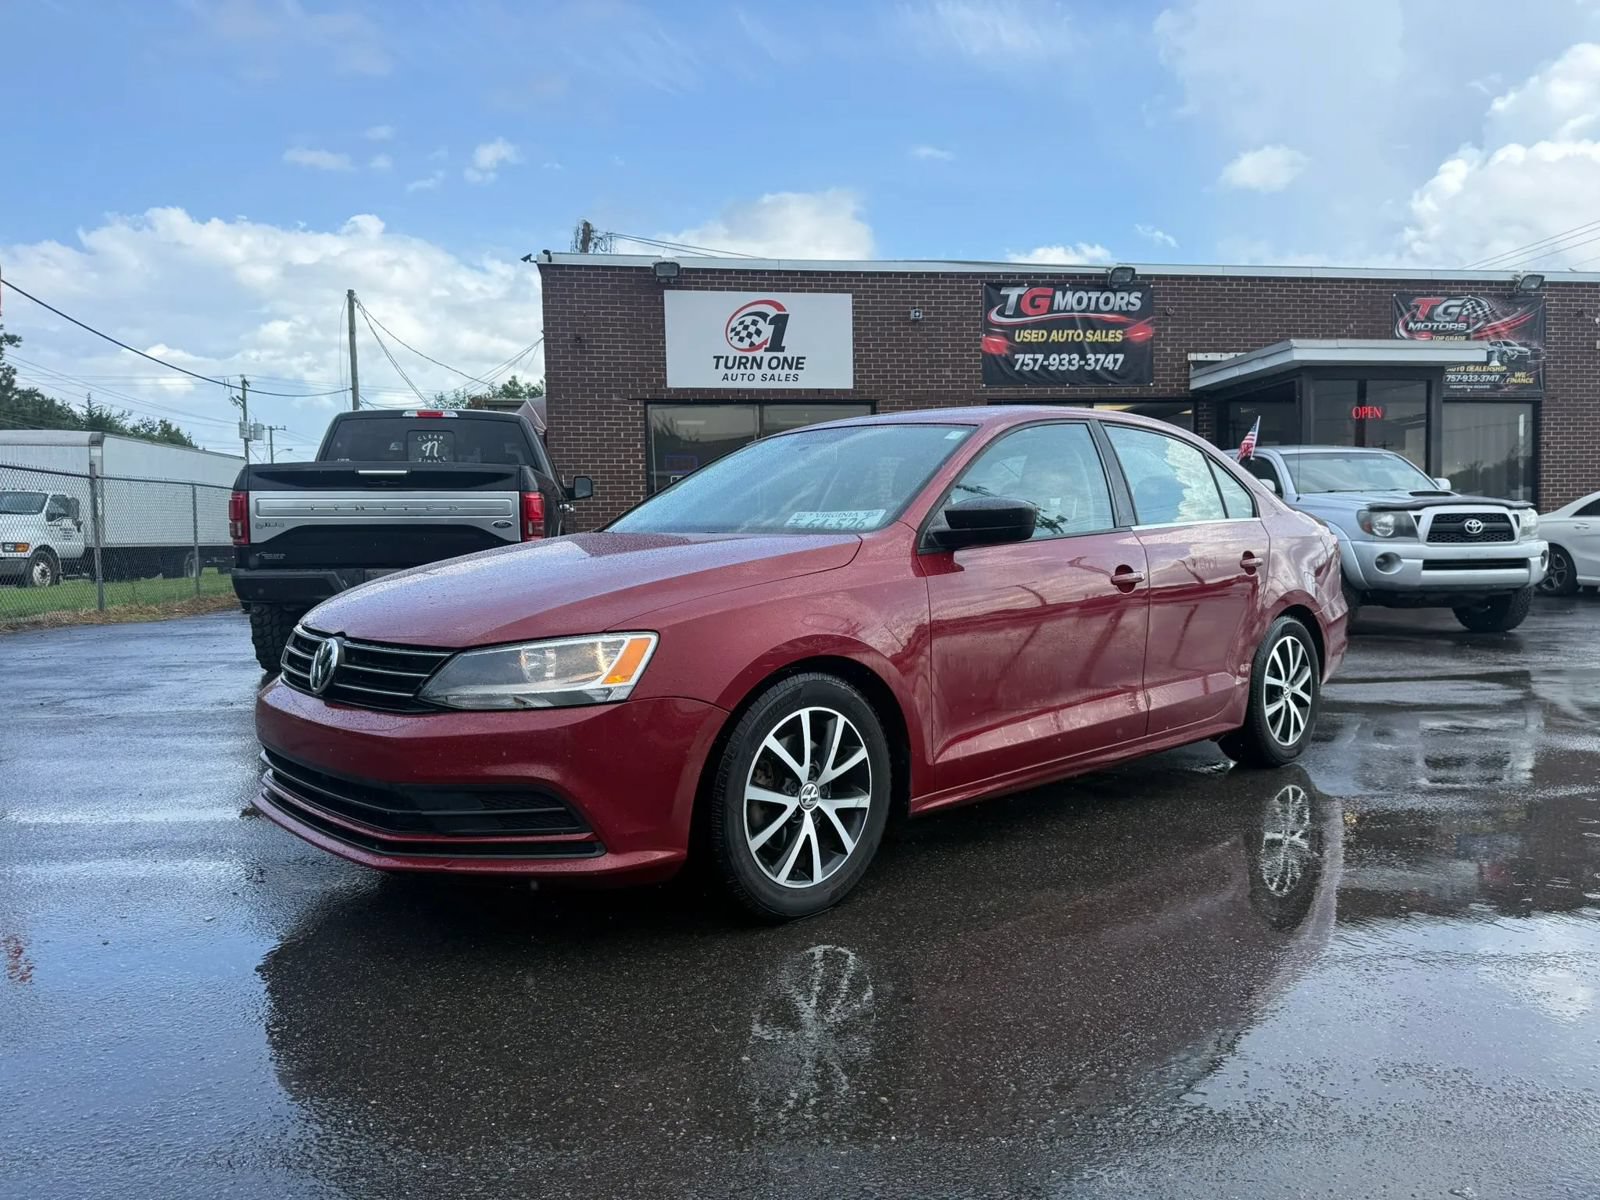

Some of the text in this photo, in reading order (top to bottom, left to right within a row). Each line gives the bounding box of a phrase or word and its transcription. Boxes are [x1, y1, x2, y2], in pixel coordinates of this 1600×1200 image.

[1000, 286, 1142, 316] TG MOTORS
[1408, 322, 1467, 331] MOTORS
[1014, 329, 1123, 343] USED AUTO SALES
[712, 355, 806, 371] TURN ONE
[1014, 353, 1124, 371] 757-933-3747
[721, 373, 800, 382] AUTO SALES
[1446, 374, 1500, 382] 757-933-3747
[1352, 406, 1382, 419] OPEN
